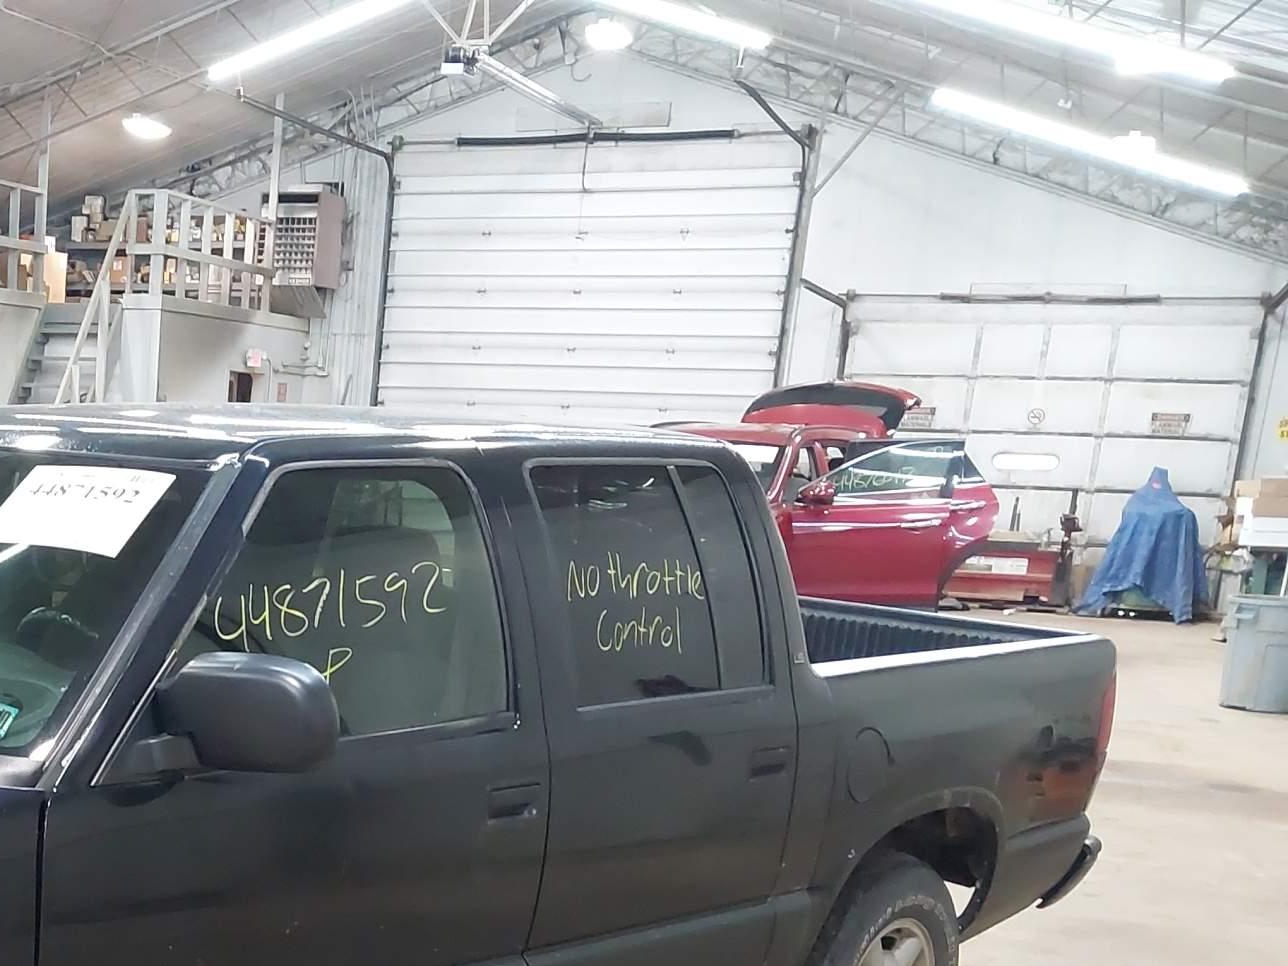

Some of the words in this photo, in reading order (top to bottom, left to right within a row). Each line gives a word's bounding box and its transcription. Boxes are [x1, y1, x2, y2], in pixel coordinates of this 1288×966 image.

[607, 551, 705, 600] throttle
[215, 561, 447, 652] 44871592
[597, 606, 682, 654] Control
